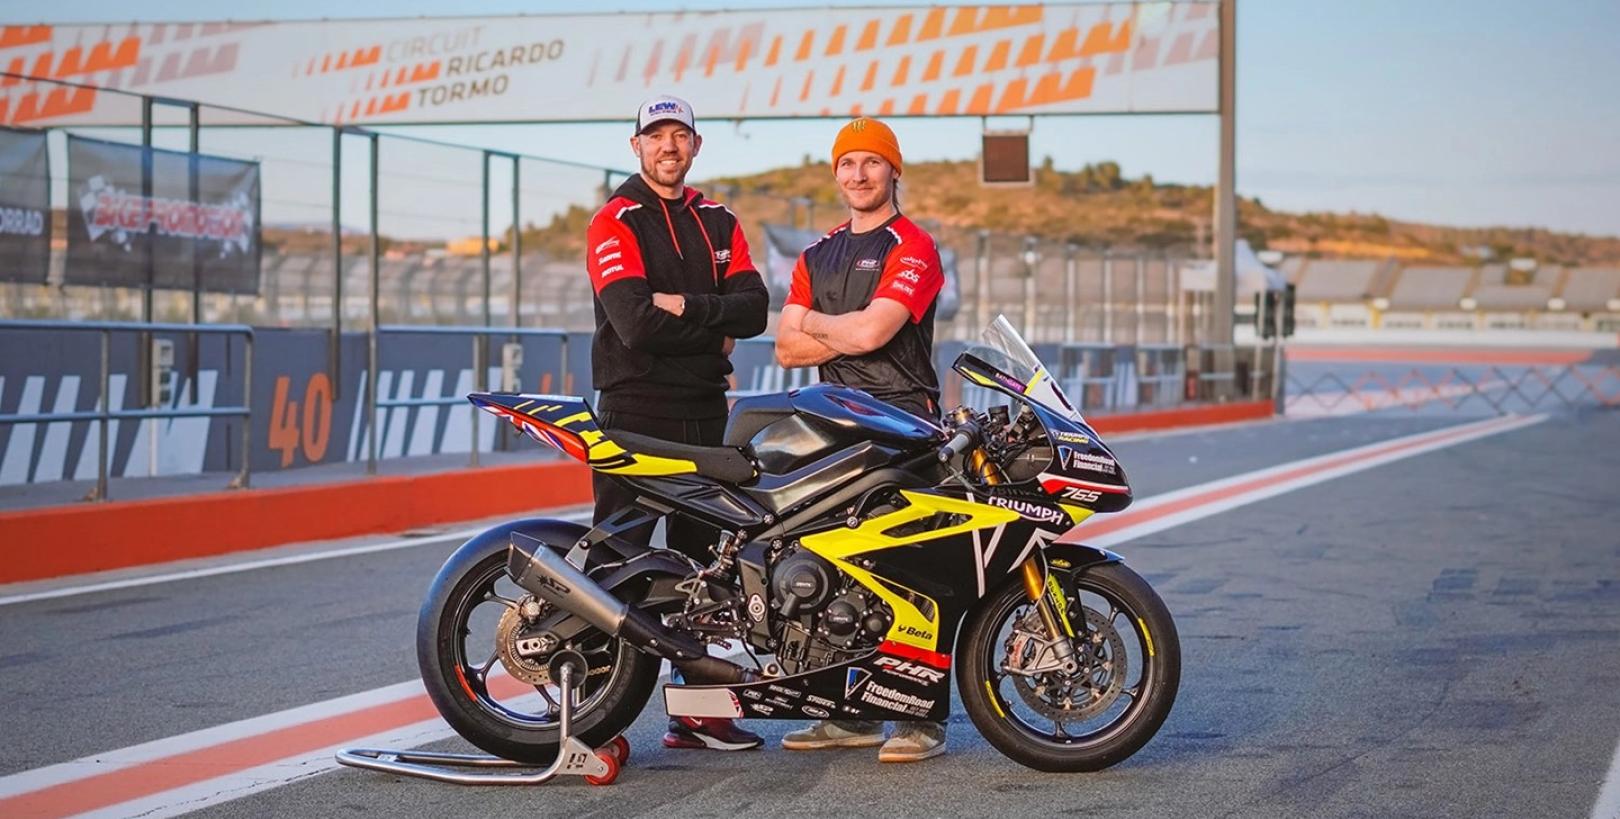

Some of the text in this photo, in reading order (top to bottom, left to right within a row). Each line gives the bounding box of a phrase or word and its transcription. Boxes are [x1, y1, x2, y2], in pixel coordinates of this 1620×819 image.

[386, 25, 486, 63] CIRCUIT
[447, 39, 565, 77] RICARDO
[418, 74, 510, 108] TORMO
[269, 372, 333, 468] 40
[1073, 460, 1103, 472] Financial
[1061, 486, 1102, 502] 765
[988, 496, 1064, 525] TRIUMPH
[906, 626, 933, 640] Beta
[873, 656, 945, 683] PHR
[861, 692, 908, 713] Financial
[866, 680, 935, 710] FreedomRoad
